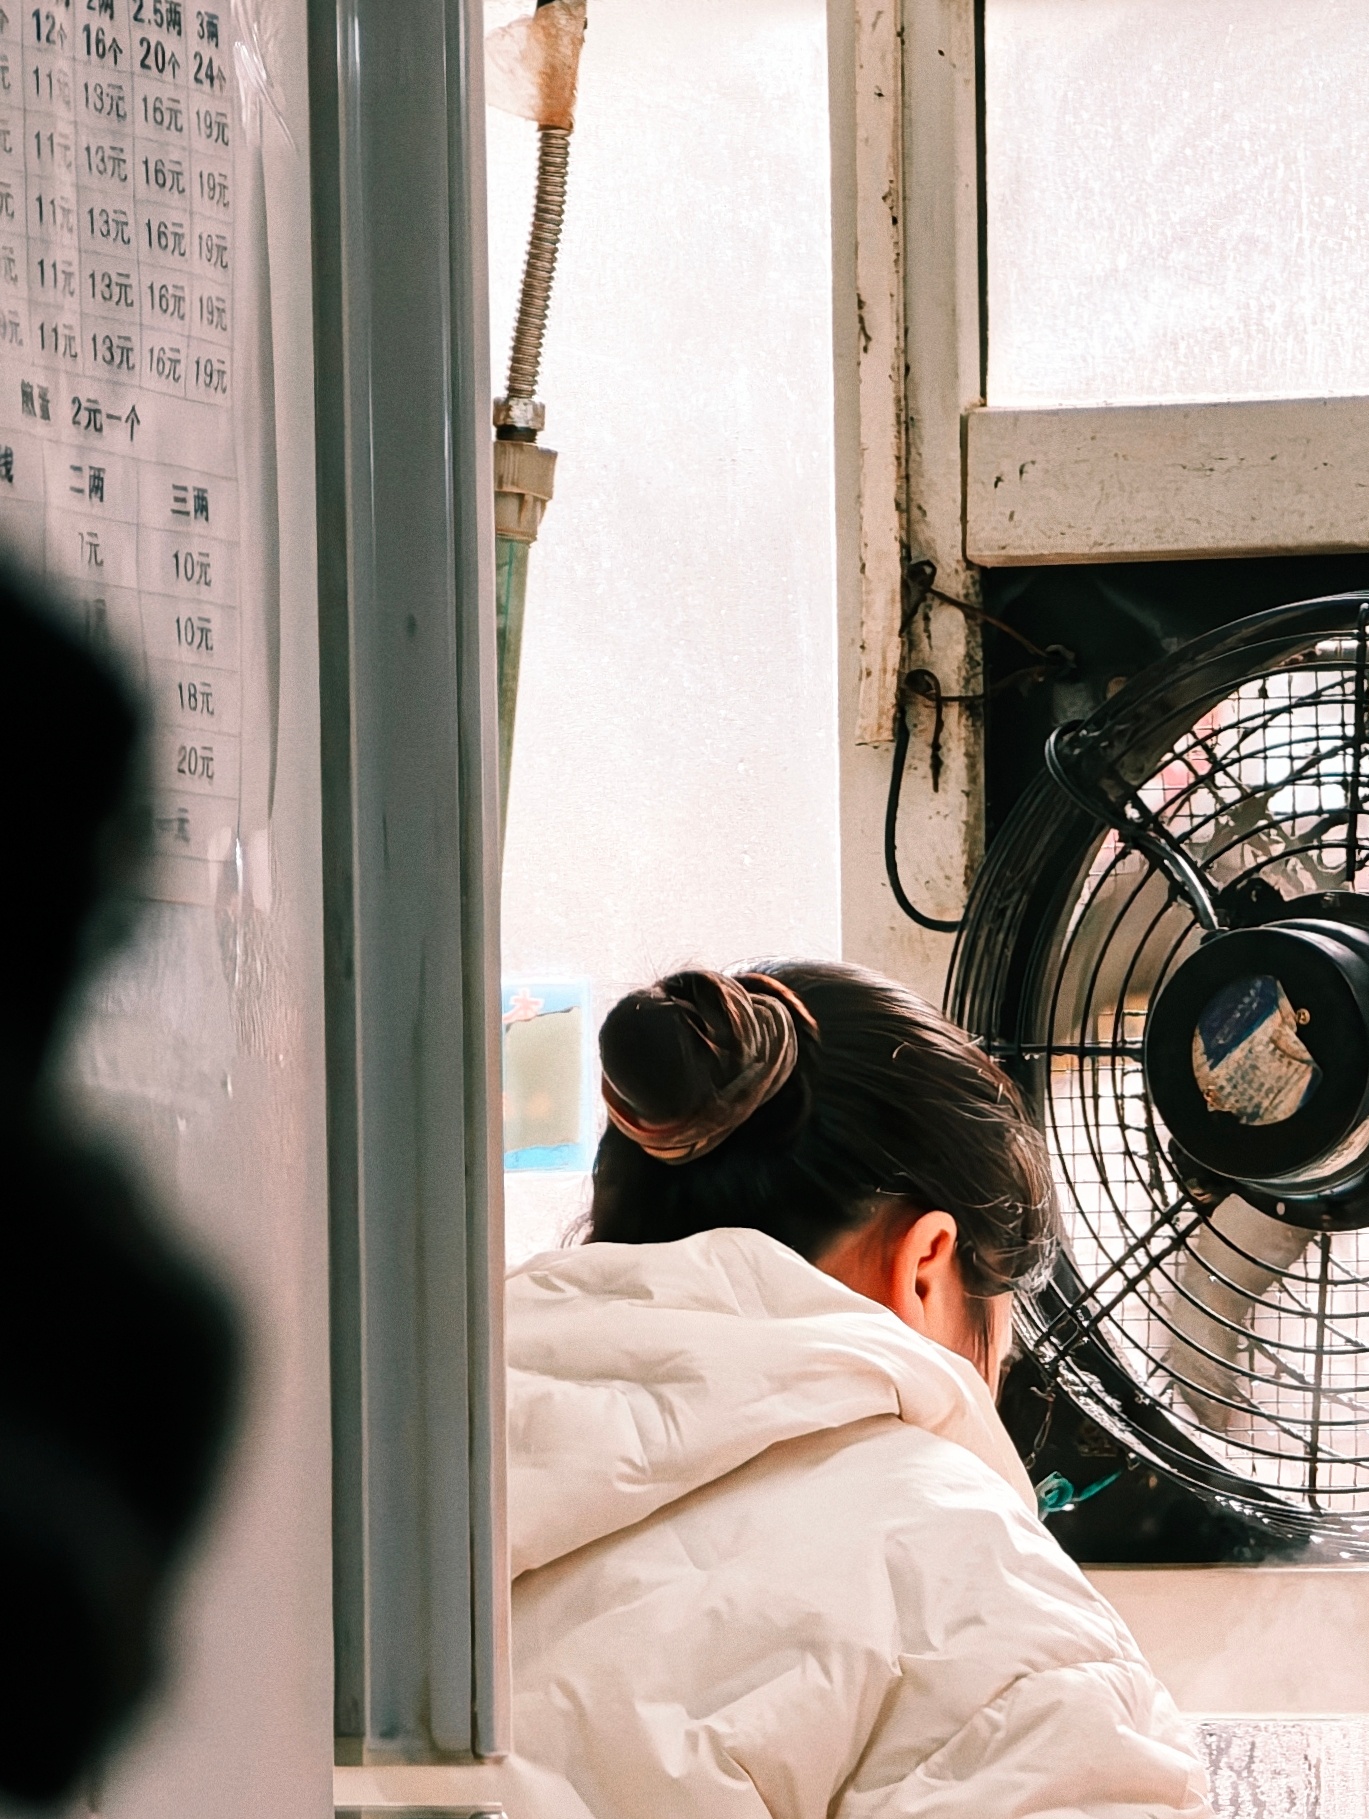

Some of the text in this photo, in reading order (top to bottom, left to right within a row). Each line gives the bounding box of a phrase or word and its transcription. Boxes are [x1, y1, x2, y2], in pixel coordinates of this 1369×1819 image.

[32, 8, 67, 48] 12个
[82, 23, 123, 66] 16个
[139, 37, 180, 79] 20个
[193, 51, 226, 94] 24个
[196, 11, 219, 49] 3两
[83, 81, 127, 121] 13元
[142, 95, 183, 133] 16元
[196, 108, 229, 146] 19元
[84, 143, 128, 182] 13元
[142, 156, 186, 195] 16元
[199, 170, 229, 208] 19元
[35, 193, 73, 233] 11元
[87, 207, 131, 245] 13元
[145, 218, 186, 257] 16元
[199, 232, 228, 269] 19元
[37, 258, 75, 298] 11元
[88, 270, 134, 307] 13元
[147, 282, 186, 321] 16元
[199, 295, 228, 331] 19元
[38, 322, 78, 359] 11元
[91, 334, 135, 371] 13元
[148, 346, 181, 383] 16元
[194, 358, 228, 394] 19元
[71, 396, 140, 442] 2元一个
[70, 464, 106, 502] 二两
[170, 484, 210, 523] 三两
[173, 551, 211, 587] 10元
[175, 616, 214, 651] 10元
[178, 682, 214, 716] 18元
[177, 746, 214, 782] 20元
